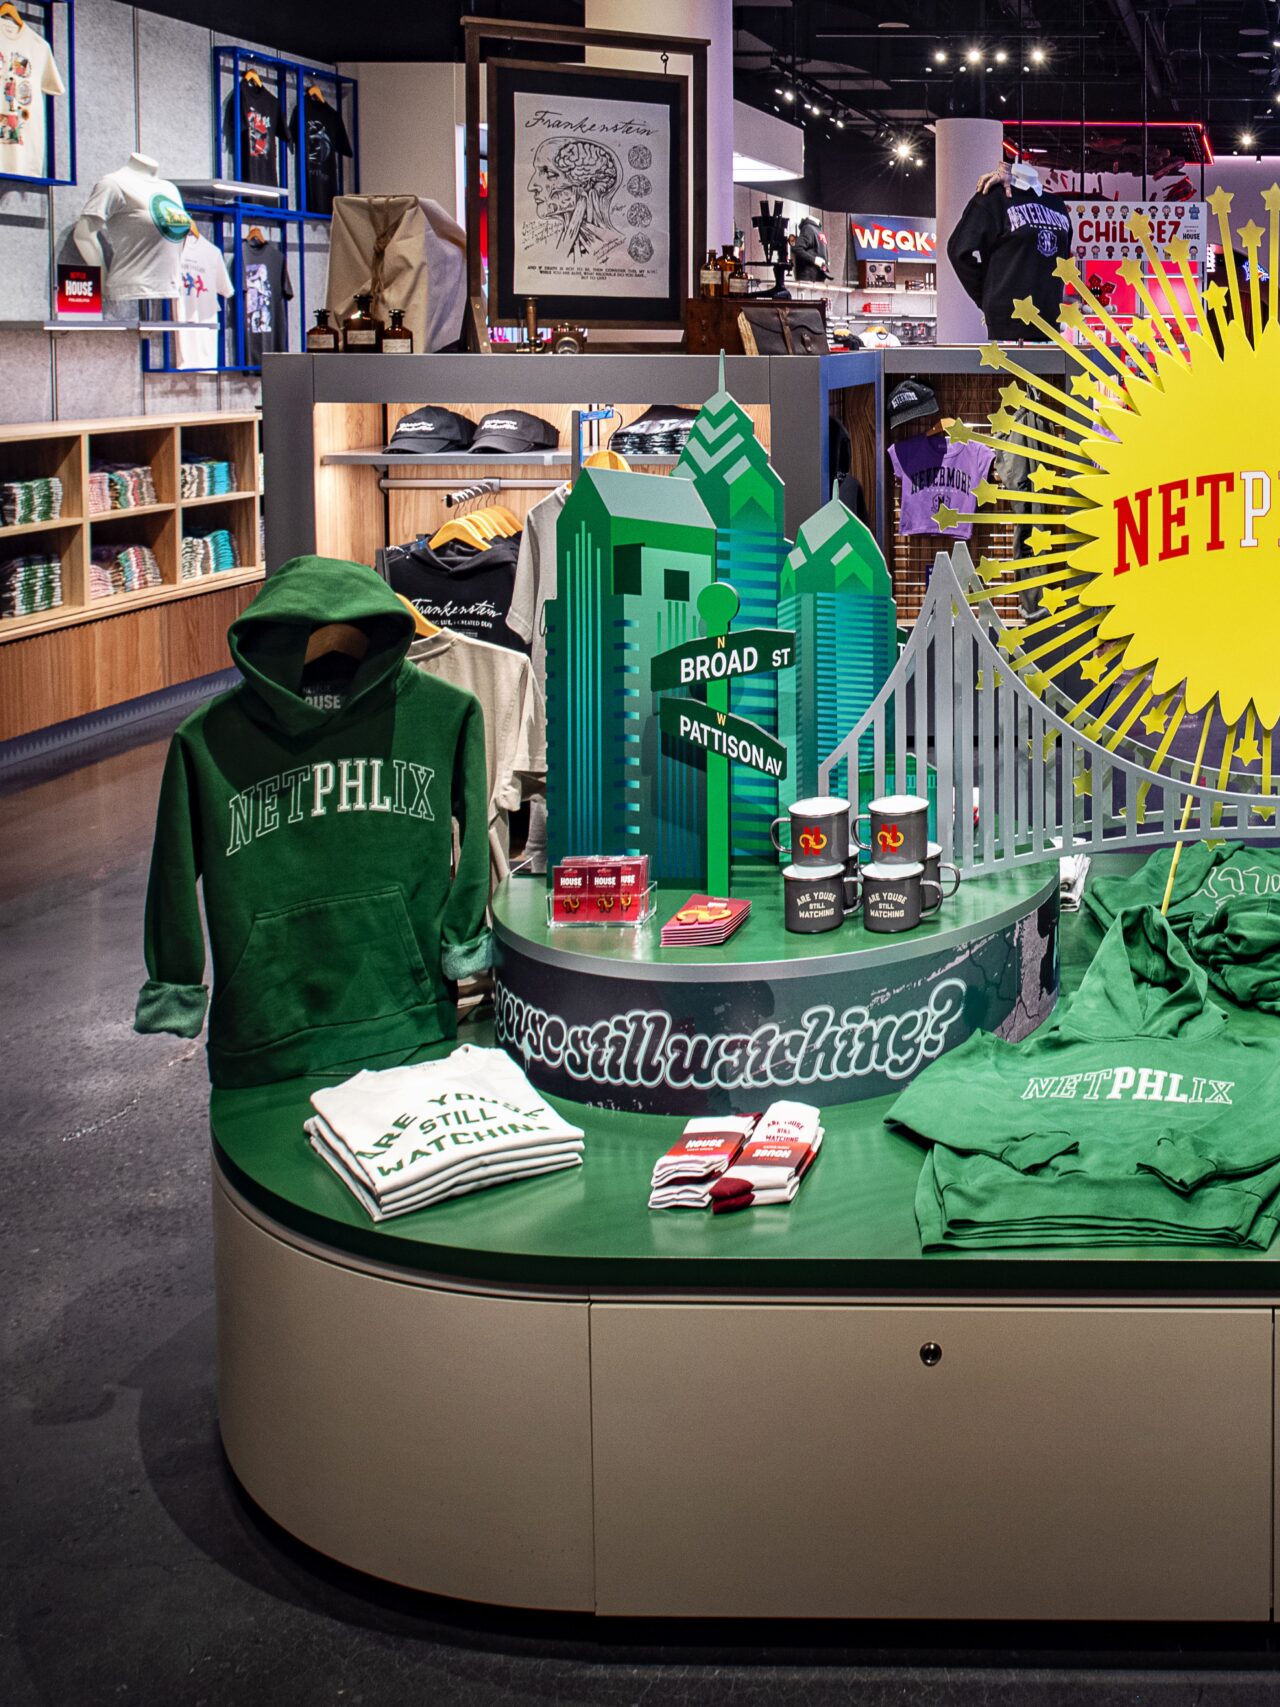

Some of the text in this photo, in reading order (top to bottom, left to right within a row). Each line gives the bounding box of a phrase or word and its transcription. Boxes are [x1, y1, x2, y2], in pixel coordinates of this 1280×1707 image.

[525, 110, 658, 136] Frankenstein
[855, 228, 932, 252] WSQK
[65, 280, 93, 297] HOUSE
[411, 598, 502, 618] Frankenstein
[717, 636, 726, 649] N
[680, 646, 791, 684] BROAD ST
[305, 694, 341, 710] OUSE
[716, 712, 727, 726] W
[680, 714, 783, 776] PATTISON AV
[226, 757, 435, 857] NETPHLIX
[560, 876, 582, 886] HOUSE
[594, 876, 616, 886] HOUSE
[620, 875, 635, 885] USE
[796, 891, 837, 906] ARE YOUSE
[808, 902, 826, 910] STILL
[868, 892, 908, 905] ARE YOUSE
[798, 908, 835, 919] WATCHING
[869, 909, 905, 918] WATCHING
[565, 1008, 672, 1088] still
[667, 977, 968, 1090] watching?
[1021, 1066, 1235, 1104] NETPHLIX
[418, 1107, 497, 1135] STILL
[355, 1112, 418, 1160] ARE
[685, 1138, 725, 1149] HOUSE
[752, 1149, 792, 1158] HOUSE
